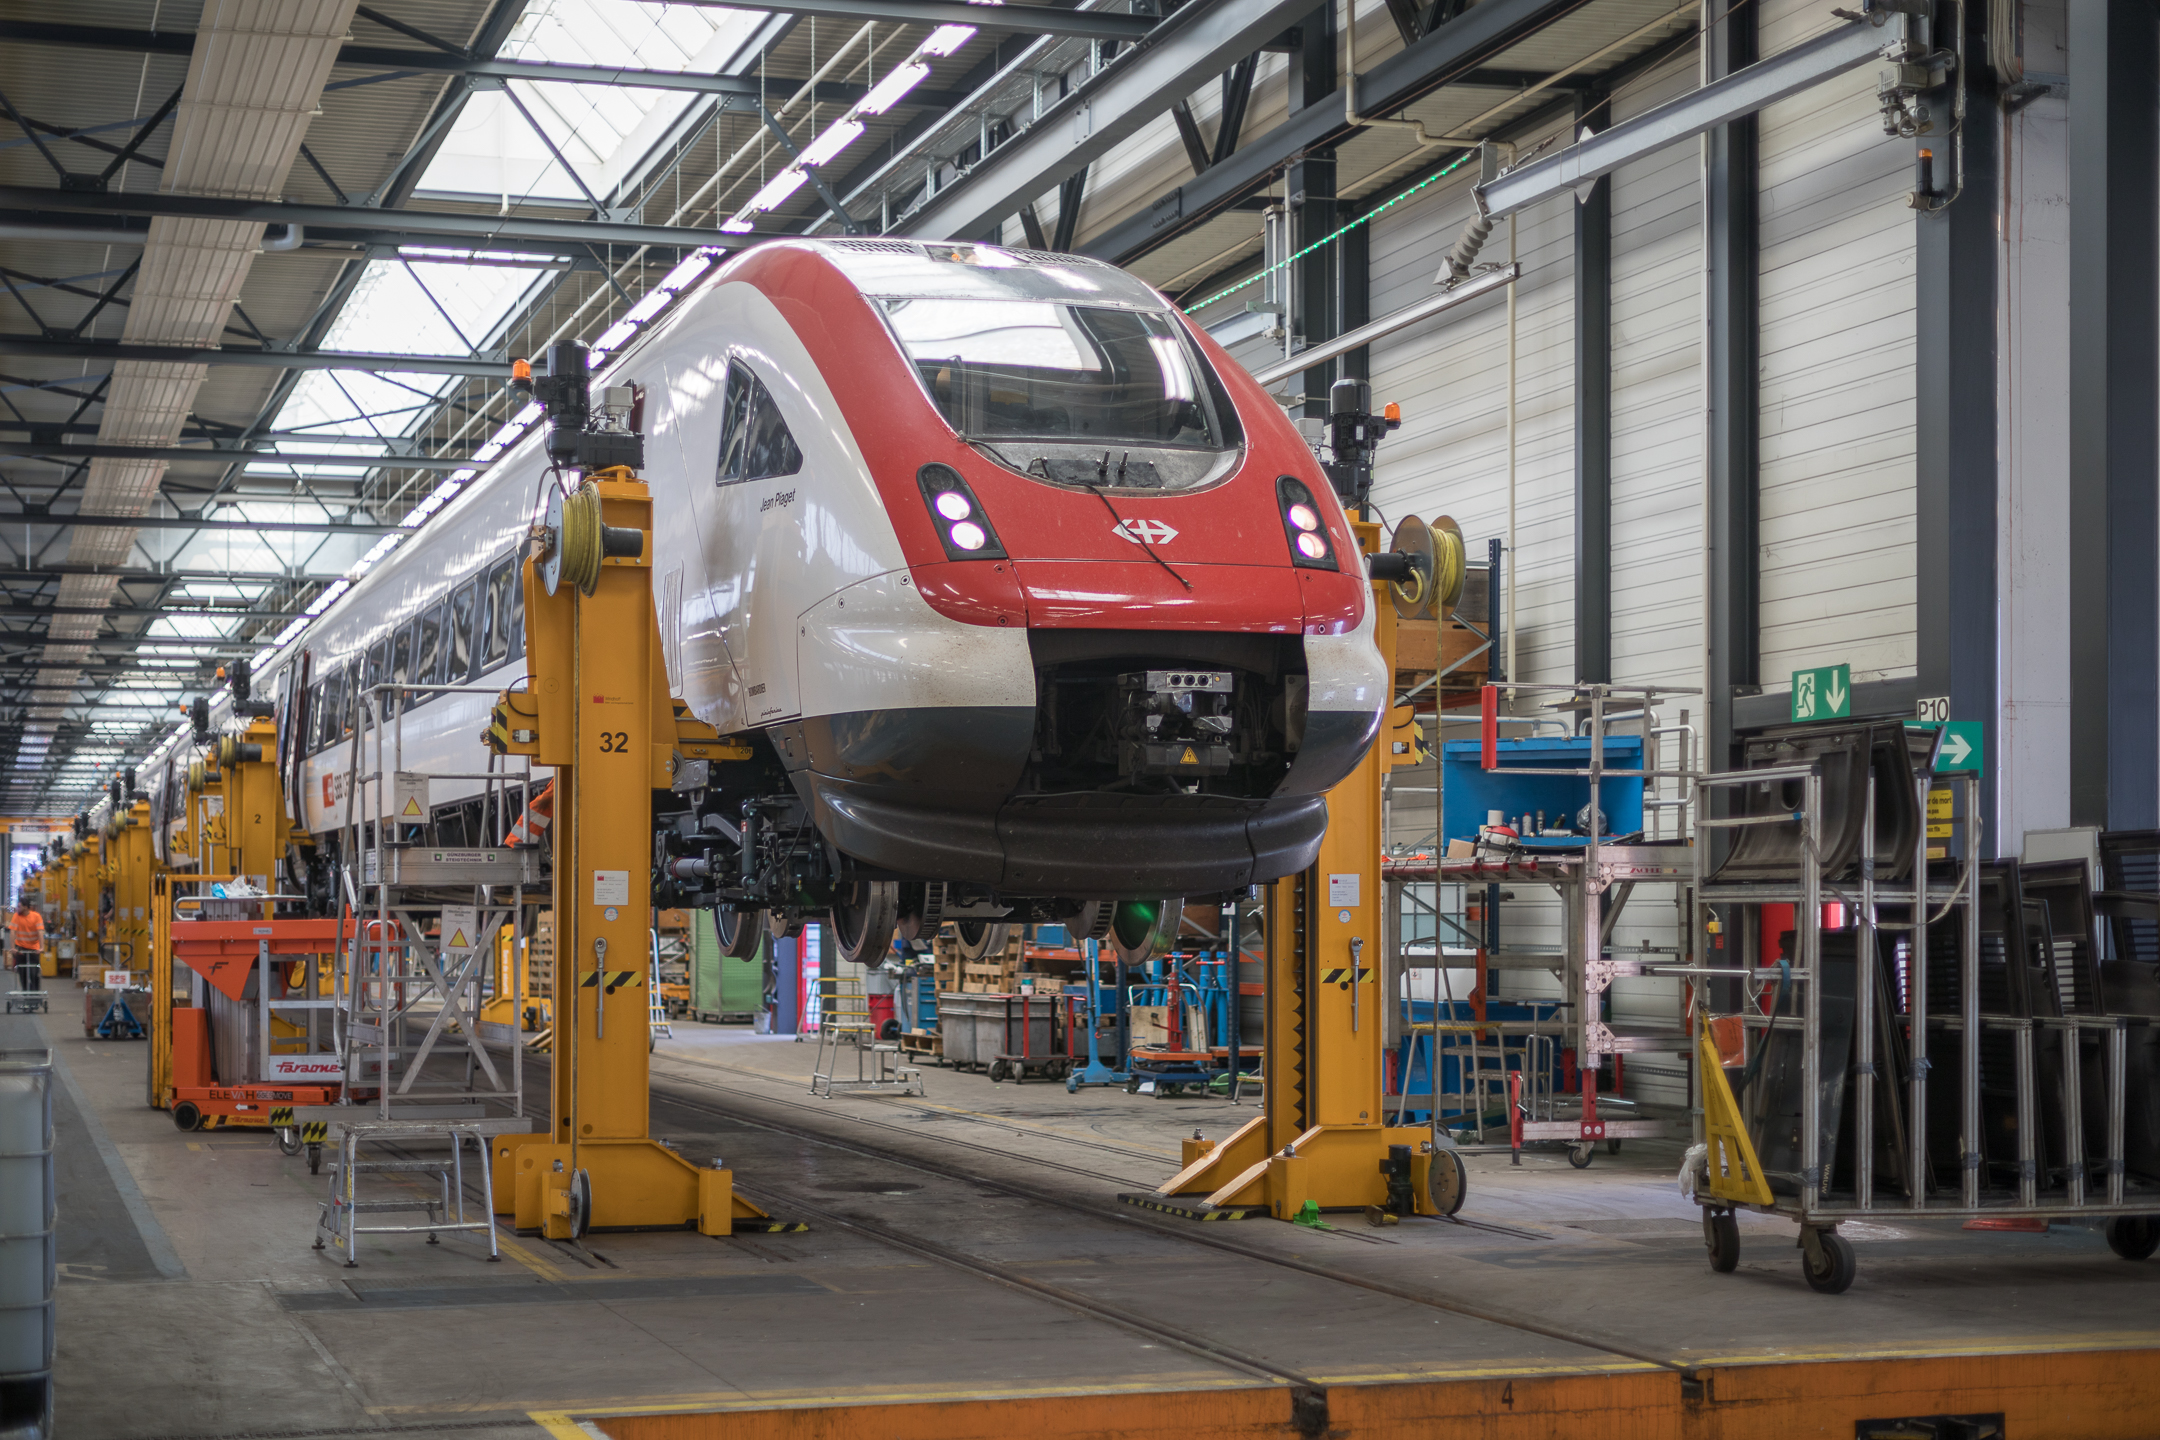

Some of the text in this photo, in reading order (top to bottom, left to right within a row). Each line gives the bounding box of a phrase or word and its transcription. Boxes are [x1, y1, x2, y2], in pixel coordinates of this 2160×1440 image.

[760, 488, 796, 512] Jean Piaget
[748, 683, 766, 697] BOMBARDIER
[1918, 698, 1949, 721] P10
[599, 731, 629, 753] 32
[334, 774, 343, 800] SBB
[254, 813, 262, 824] 2
[276, 1061, 341, 1073] Faraone
[209, 1090, 255, 1100] ELEVAH
